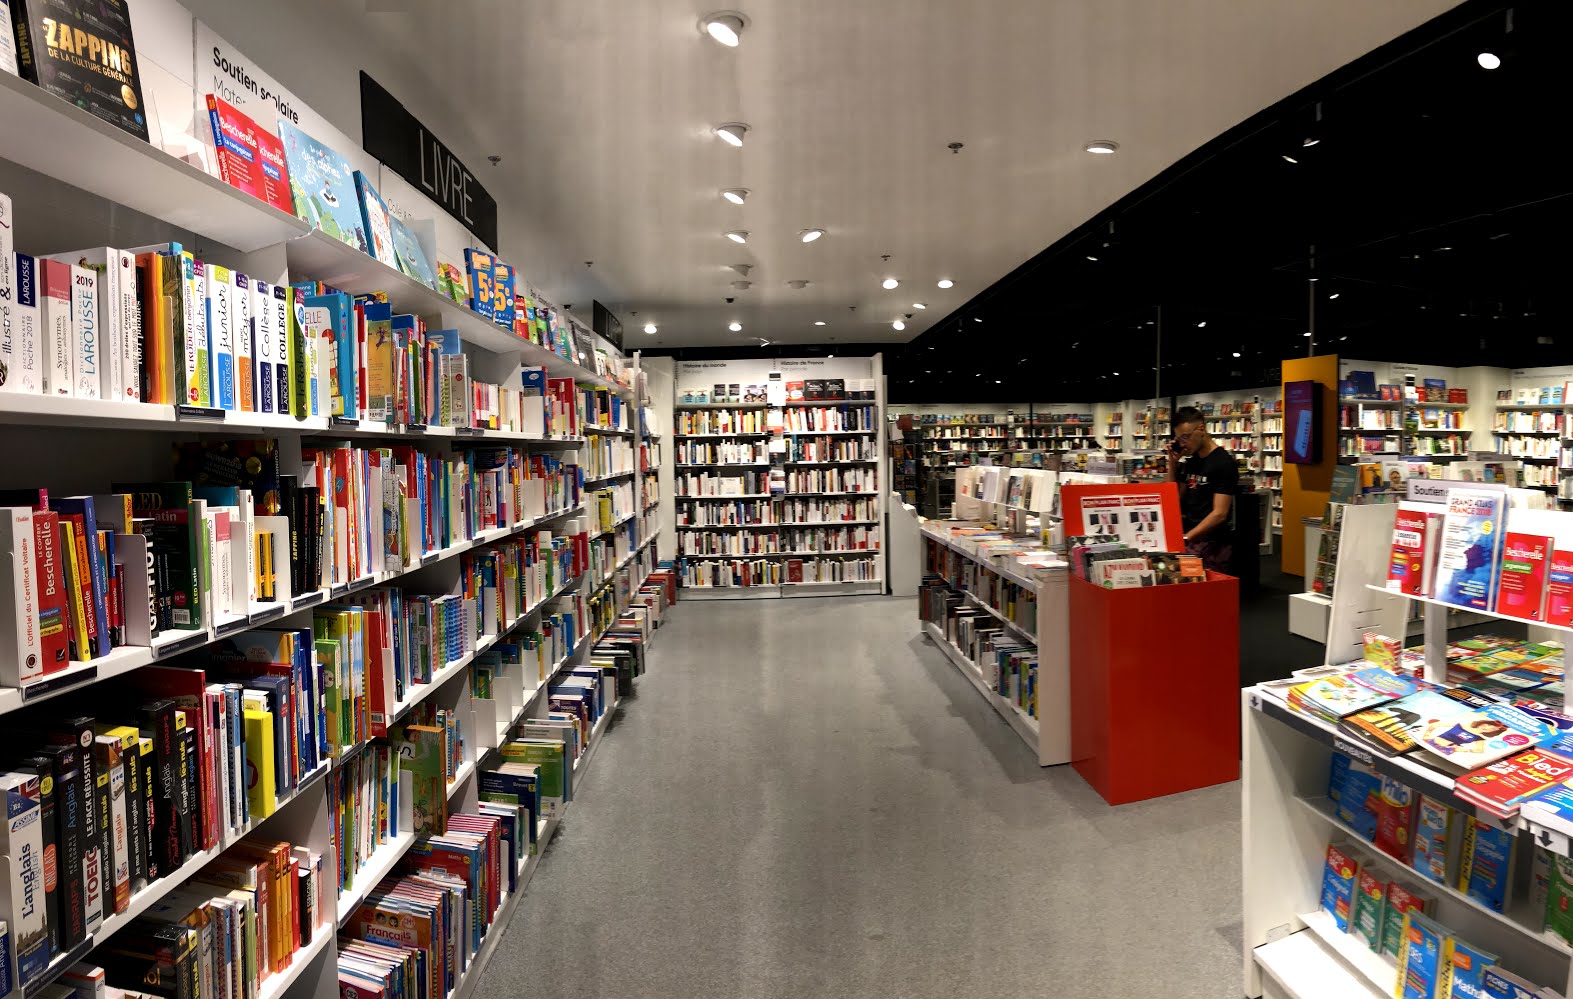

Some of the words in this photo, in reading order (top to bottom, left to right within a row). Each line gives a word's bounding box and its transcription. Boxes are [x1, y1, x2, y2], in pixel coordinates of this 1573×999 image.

[17, 22, 31, 66] ZAPPING
[42, 17, 133, 77] ZAPPING
[47, 47, 59, 60] DE
[60, 51, 71, 63] LA
[71, 56, 102, 74] CULTURE
[102, 66, 134, 87] GÉNÉRALE
[213, 46, 258, 96] Soutien
[219, 116, 258, 149] Bescherelle
[419, 129, 475, 226] LIVRE
[0, 286, 11, 301] &
[22, 259, 31, 305] LAROUSSE
[76, 274, 94, 289] 2019
[1, 305, 12, 355] illustré
[83, 290, 96, 375] LAROUSSE
[196, 280, 206, 347] débutants
[217, 285, 231, 352] junior
[242, 293, 251, 354] major
[260, 297, 270, 358] Collège
[278, 303, 286, 361] COLLEGE
[26, 341, 34, 371] Poche
[200, 352, 209, 406] LAROUSSE
[223, 356, 233, 407] LAROUSSE
[264, 365, 273, 412] LAROUSSE
[281, 367, 289, 414] LAROUSSE
[1414, 485, 1445, 497] Soutien
[1449, 505, 1475, 516] FRANCE
[1451, 498, 1473, 507] GRAND
[21, 537, 29, 565] Voltaire
[42, 521, 57, 597] Bescherelle
[79, 539, 87, 574] vocabulaire
[25, 602, 32, 613] du
[86, 590, 95, 635] Bescherelle
[83, 752, 91, 796] RÉUSSITE
[163, 763, 172, 799] Anglais
[1514, 749, 1571, 777] Bled
[66, 782, 77, 829] Anglais
[85, 797, 93, 824] PACK
[86, 823, 93, 837] LE
[20, 843, 35, 920] L'anglais
[44, 848, 56, 890] ANGLAIS
[86, 845, 98, 907] TOEIC
[71, 878, 80, 936] HARRAP'S
[366, 924, 411, 941] Français
